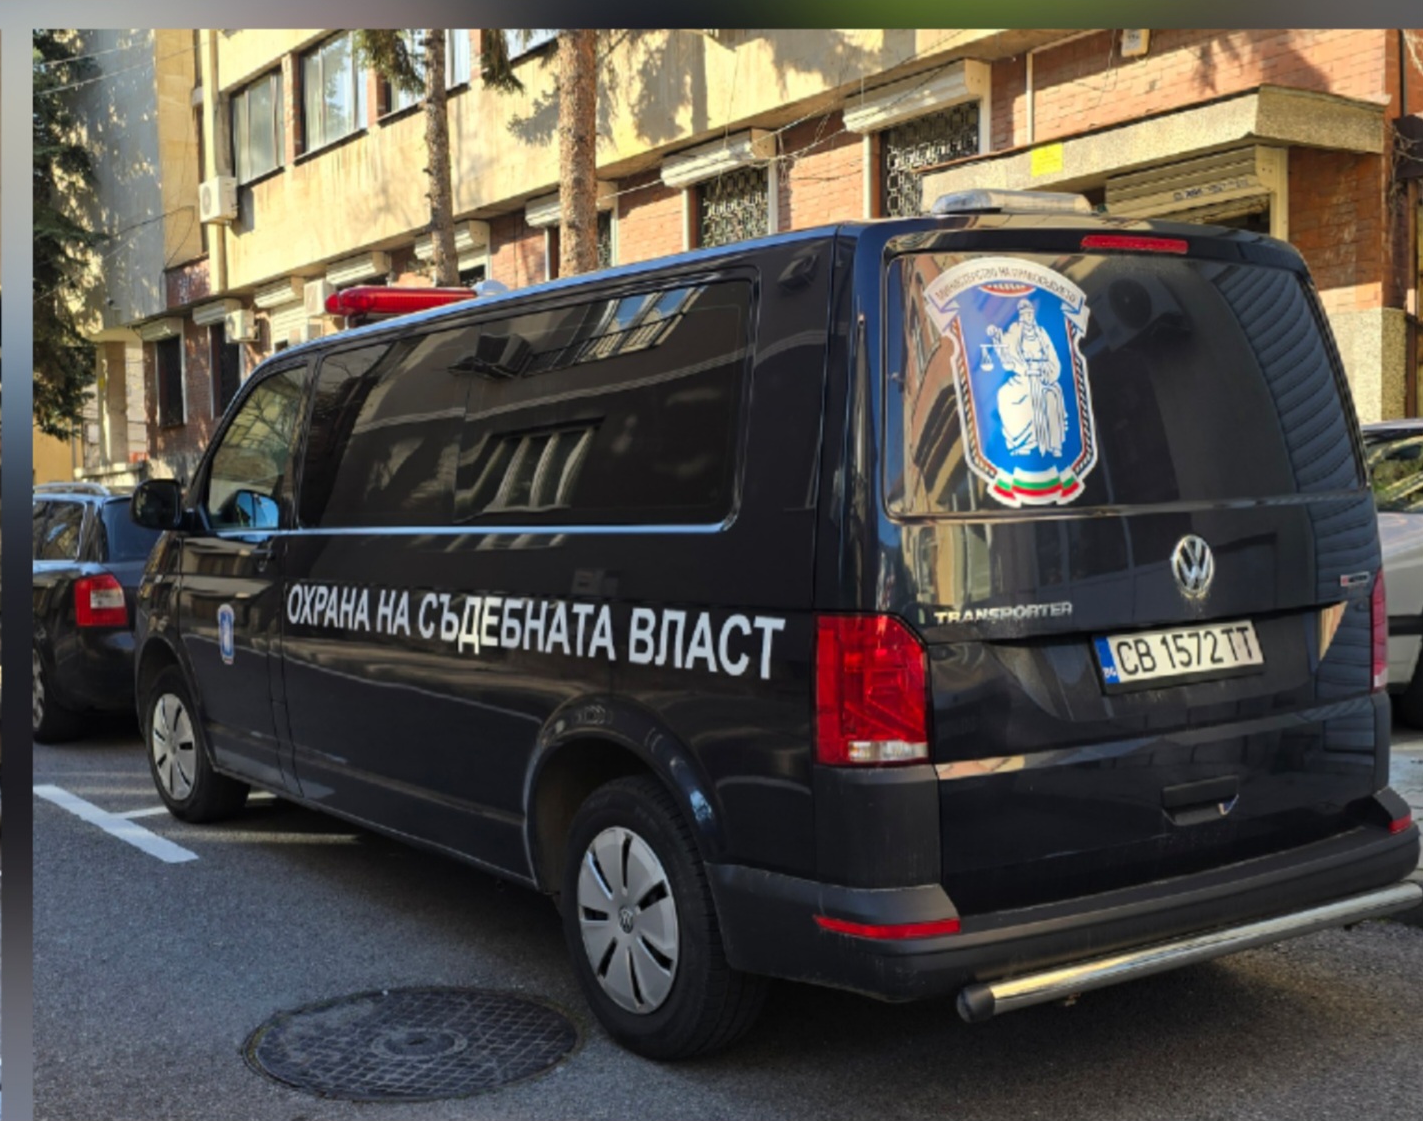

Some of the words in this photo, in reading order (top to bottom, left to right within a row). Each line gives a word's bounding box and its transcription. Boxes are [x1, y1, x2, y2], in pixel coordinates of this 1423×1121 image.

[287, 584, 370, 631] ОХРАНА
[376, 590, 410, 638] НА
[418, 593, 616, 661] СЪДЕБНАТА
[628, 607, 786, 679] ВЛАСТ
[933, 601, 1073, 625] TRANSPORTER
[1115, 639, 1157, 676] CB
[1160, 629, 1224, 669] 1572
[1224, 625, 1256, 663] TT
